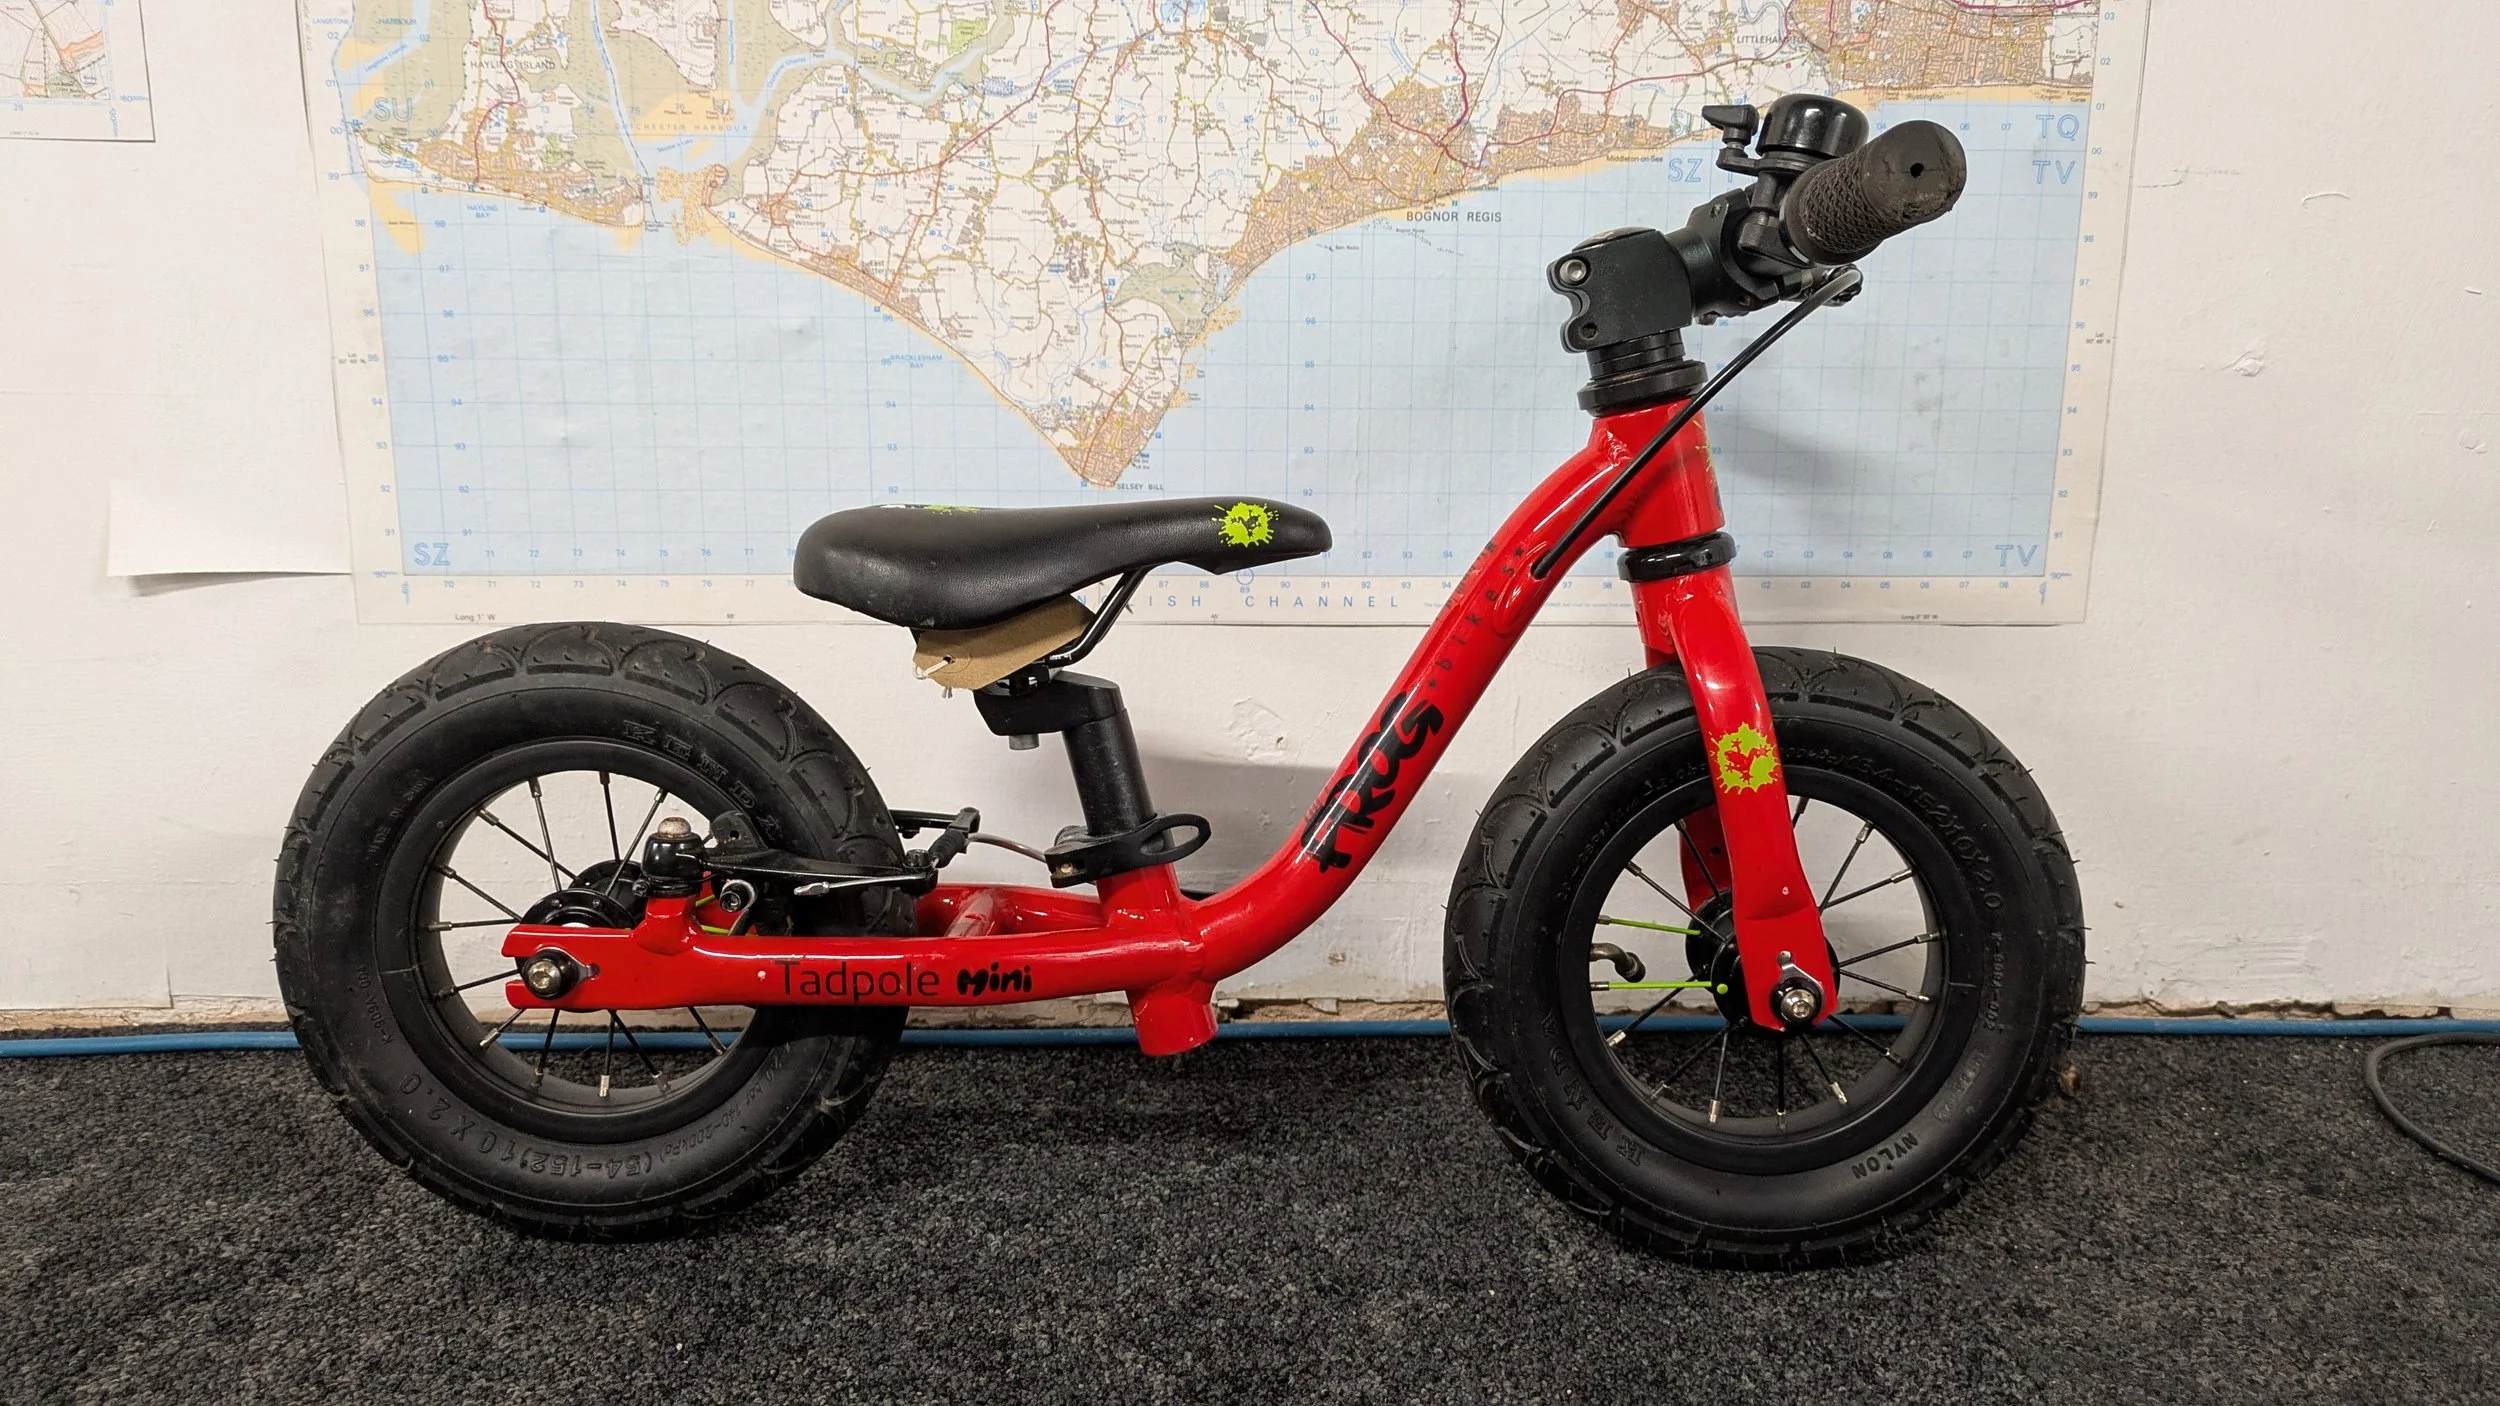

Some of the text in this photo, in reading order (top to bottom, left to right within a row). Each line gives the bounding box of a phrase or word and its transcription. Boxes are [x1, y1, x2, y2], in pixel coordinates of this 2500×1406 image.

[1737, 36, 1811, 45] LITTLEHAPTO
[470, 61, 555, 70] HAYLING ISLAND
[374, 97, 414, 122] SU
[2035, 114, 2079, 139] TQ
[1606, 155, 1663, 163] Middleton-on-Sea
[1668, 158, 1703, 182] SZ
[2032, 160, 2075, 185] TV
[475, 211, 491, 219] BAY
[1104, 218, 1139, 226] Sidlesham
[1406, 211, 1502, 223] BOGNOR REGIS
[1149, 483, 1164, 491] BILL
[414, 542, 450, 566] SZ
[1995, 544, 2038, 568] TV
[1245, 596, 1398, 607] CHANNEL
[455, 613, 475, 622] Long
[623, 718, 783, 843] KENDA
[1302, 690, 1444, 873] FROG
[774, 960, 1033, 1002] Tadpole Mini
[1541, 1012, 1645, 1167] KENDA
[1852, 1131, 1919, 1179] NYLON
